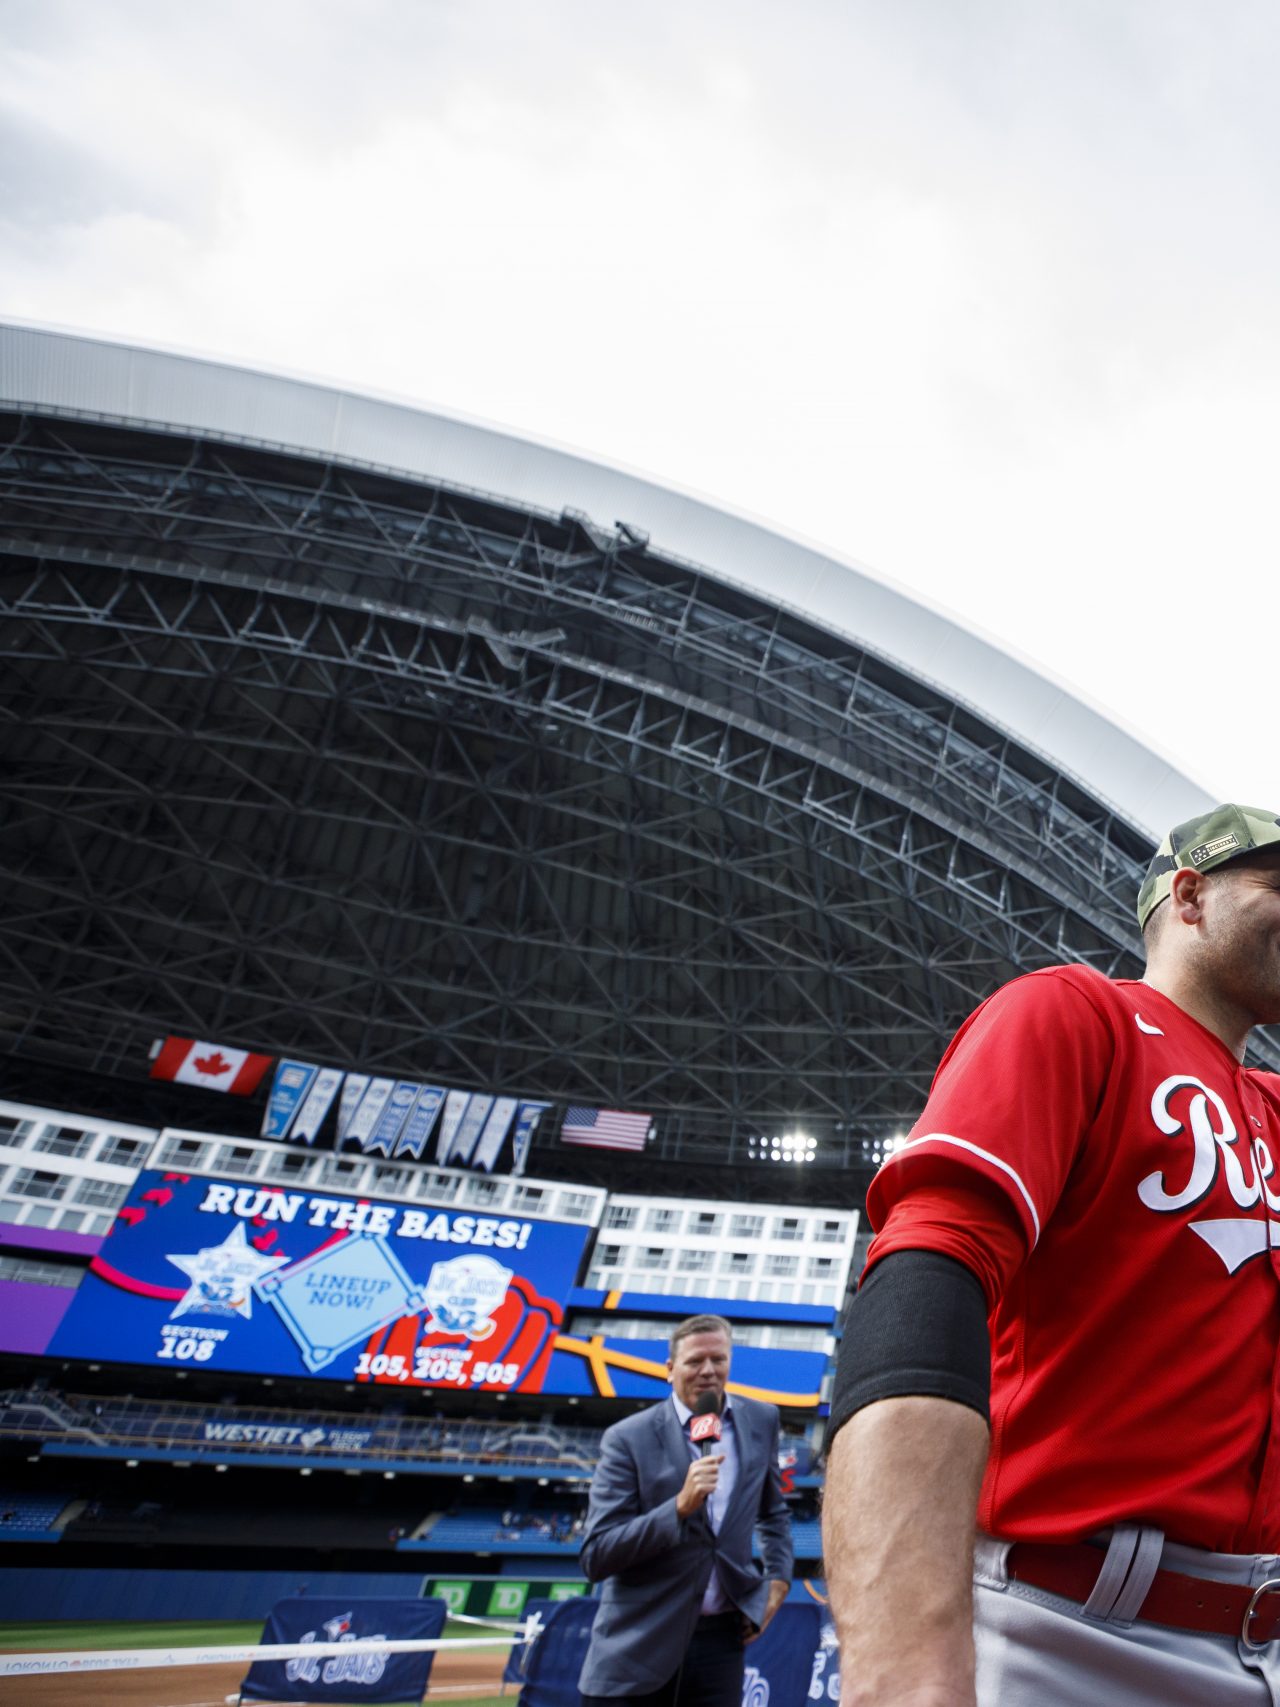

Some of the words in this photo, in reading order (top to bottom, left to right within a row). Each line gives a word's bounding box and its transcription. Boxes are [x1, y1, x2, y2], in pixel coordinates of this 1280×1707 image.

[199, 1183, 304, 1222] RUN
[308, 1198, 396, 1236] THE
[397, 1210, 533, 1250] BASES!
[304, 1272, 393, 1299] LINEUP
[308, 1290, 376, 1311] NOW!
[160, 1324, 229, 1342] SECTION
[157, 1338, 216, 1362] 108
[354, 1352, 410, 1382] 105,
[412, 1359, 468, 1385] 205,
[470, 1363, 520, 1386] 505
[205, 1423, 303, 1445] WESTJET
